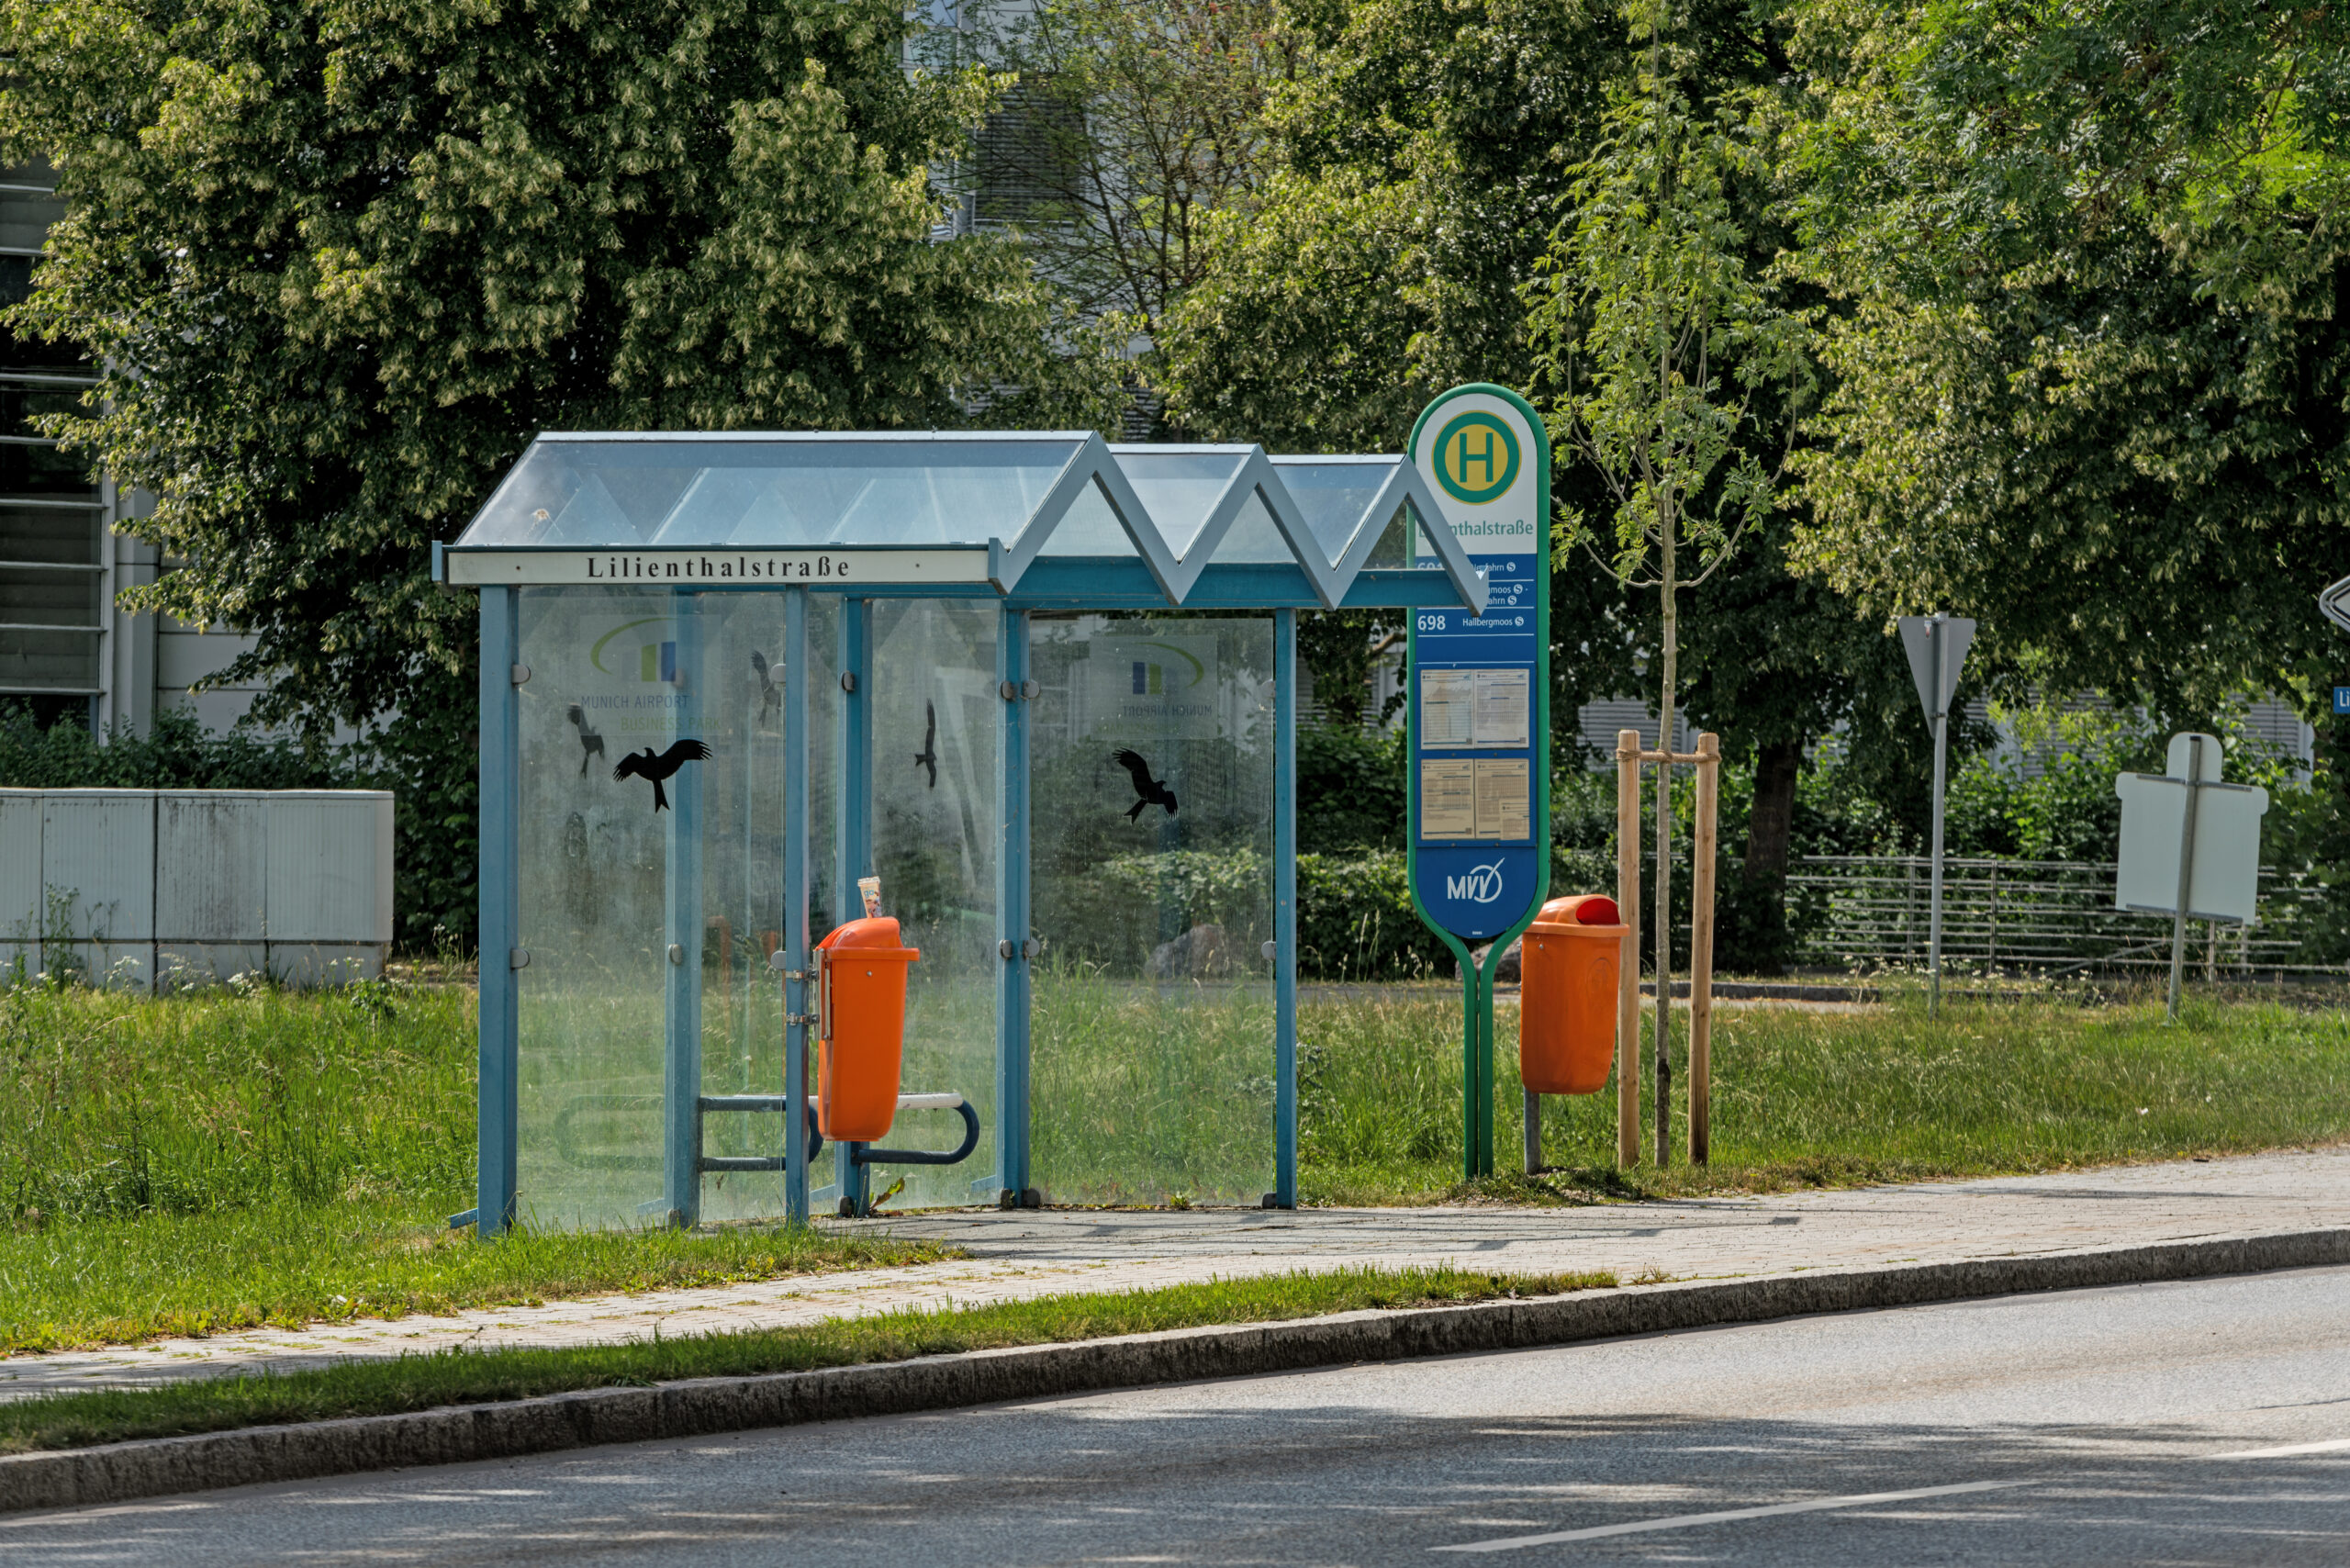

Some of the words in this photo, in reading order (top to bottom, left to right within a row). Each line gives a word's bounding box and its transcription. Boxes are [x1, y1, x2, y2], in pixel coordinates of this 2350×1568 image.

[1460, 432, 1494, 483] H
[587, 556, 849, 577] Lilienthalstraße
[1417, 615, 1446, 631] 698
[1462, 617, 1513, 628] Hallbergmoos
[581, 695, 629, 709] MUNICH
[634, 695, 689, 709] AIRPORT
[621, 716, 683, 731] BUSINESS
[688, 716, 721, 731] PARK
[1447, 857, 1505, 902] MVV
